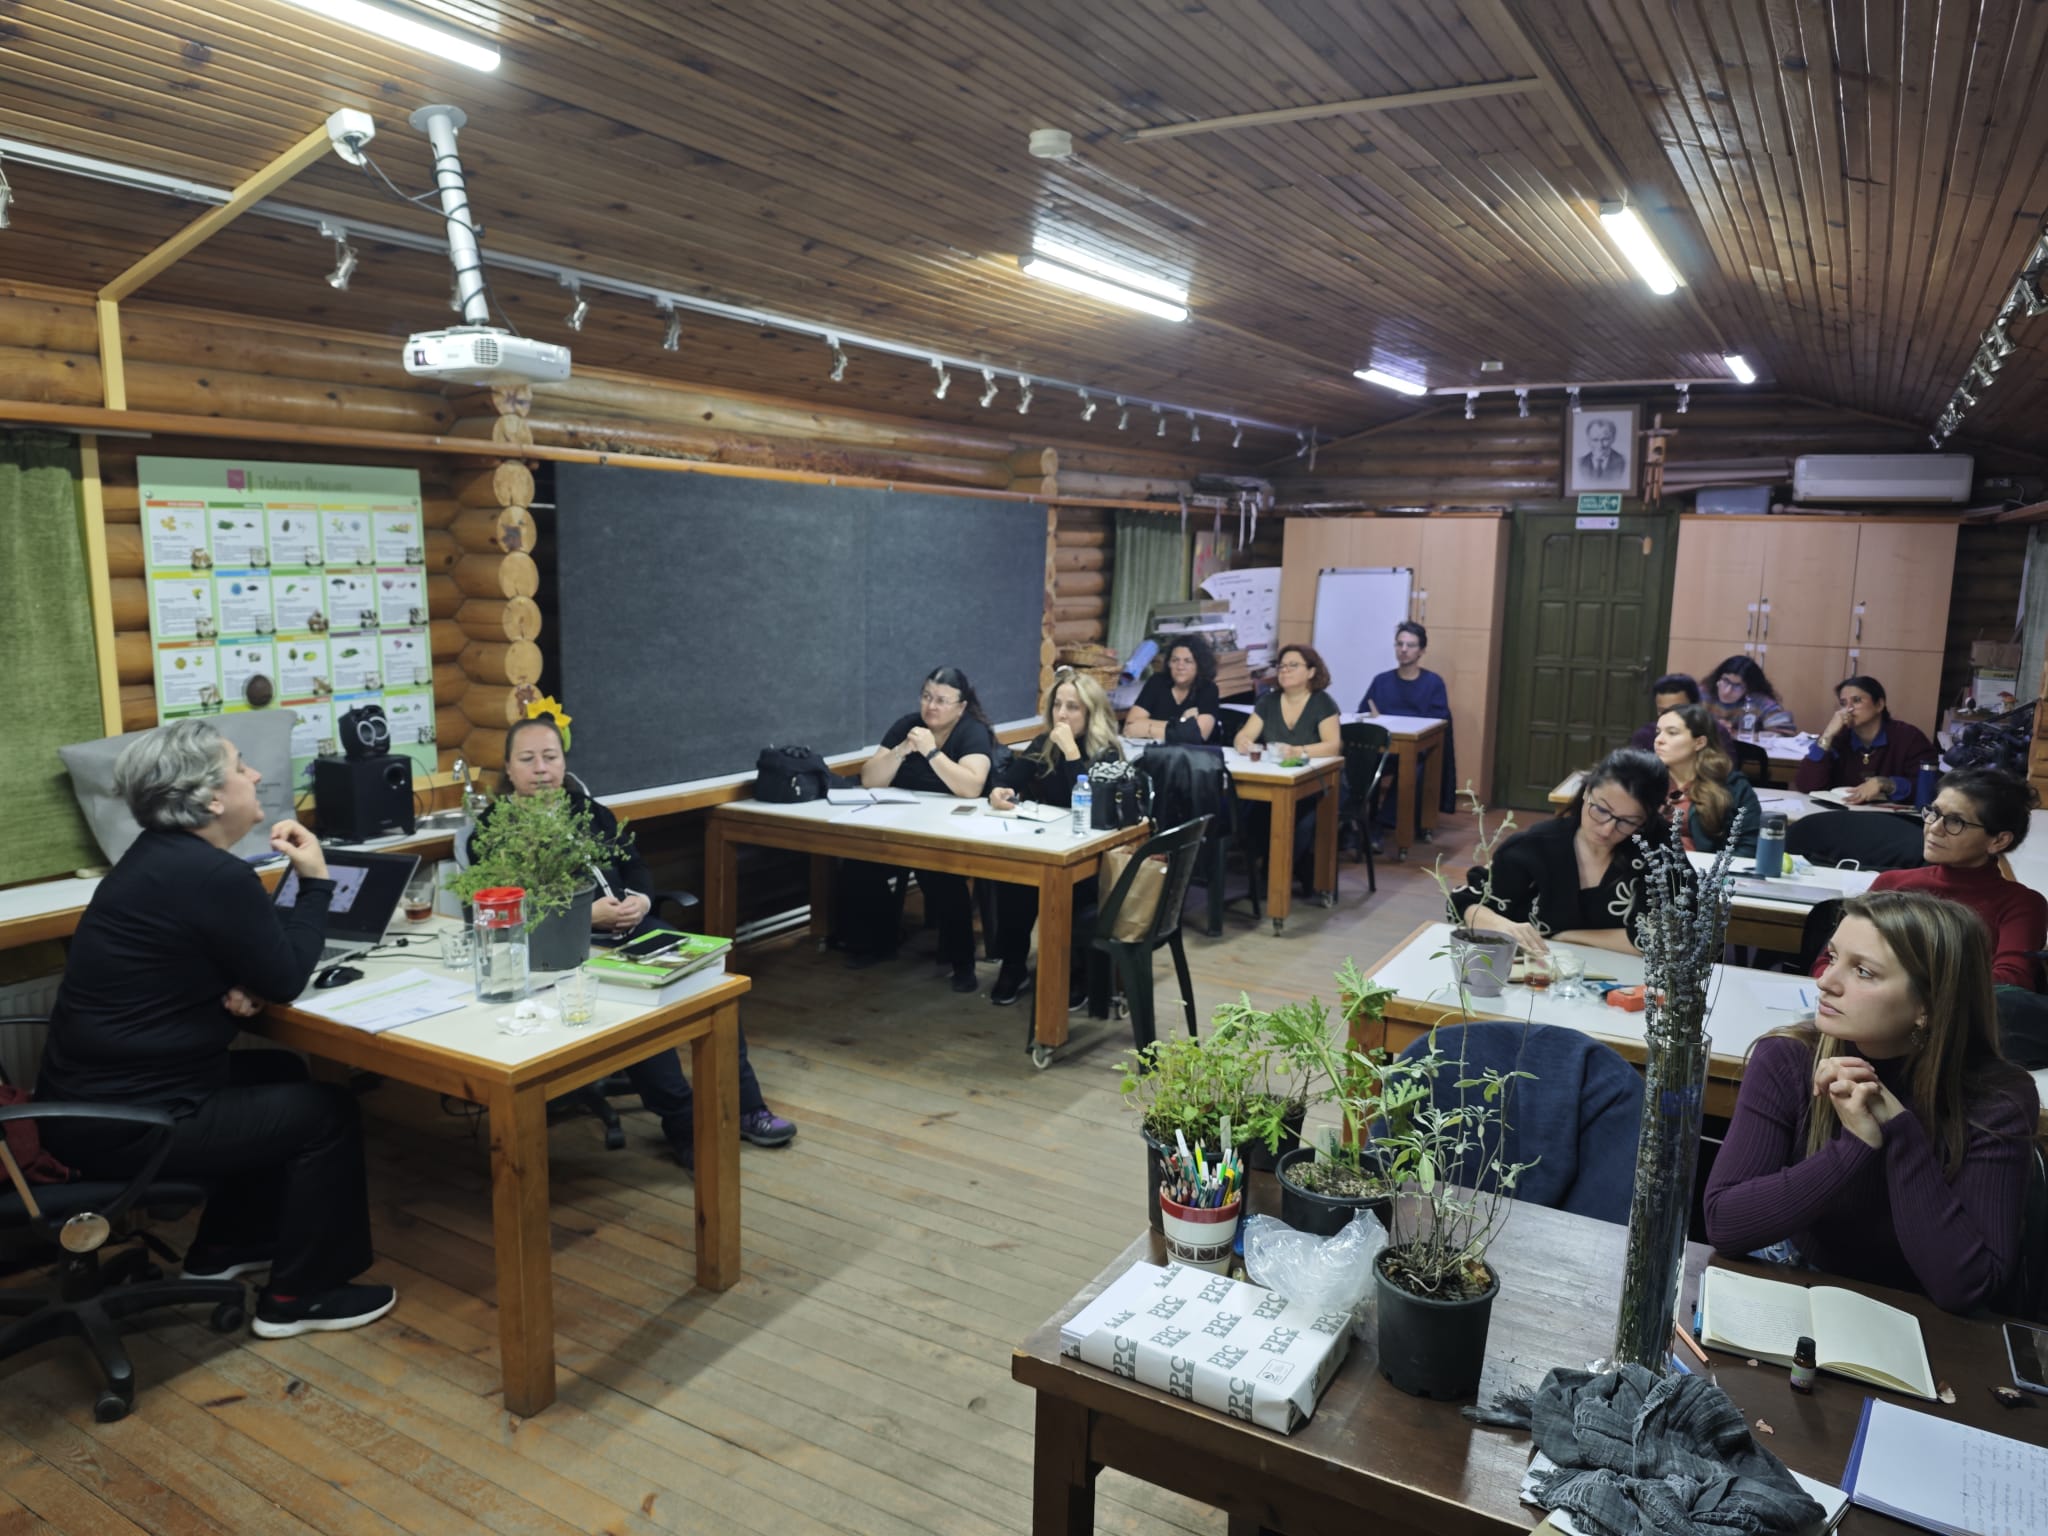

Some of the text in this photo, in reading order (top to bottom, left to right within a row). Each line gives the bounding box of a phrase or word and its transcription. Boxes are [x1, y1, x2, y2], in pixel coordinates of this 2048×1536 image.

[1197, 1276, 1227, 1303] PPC
[1146, 1295, 1178, 1319] PPC
[1252, 1292, 1281, 1319] PPC
[1150, 1325, 1182, 1346] PPC
[1201, 1311, 1233, 1336] PPC
[1259, 1326, 1290, 1353] PPC
[1207, 1344, 1240, 1367] PPC
